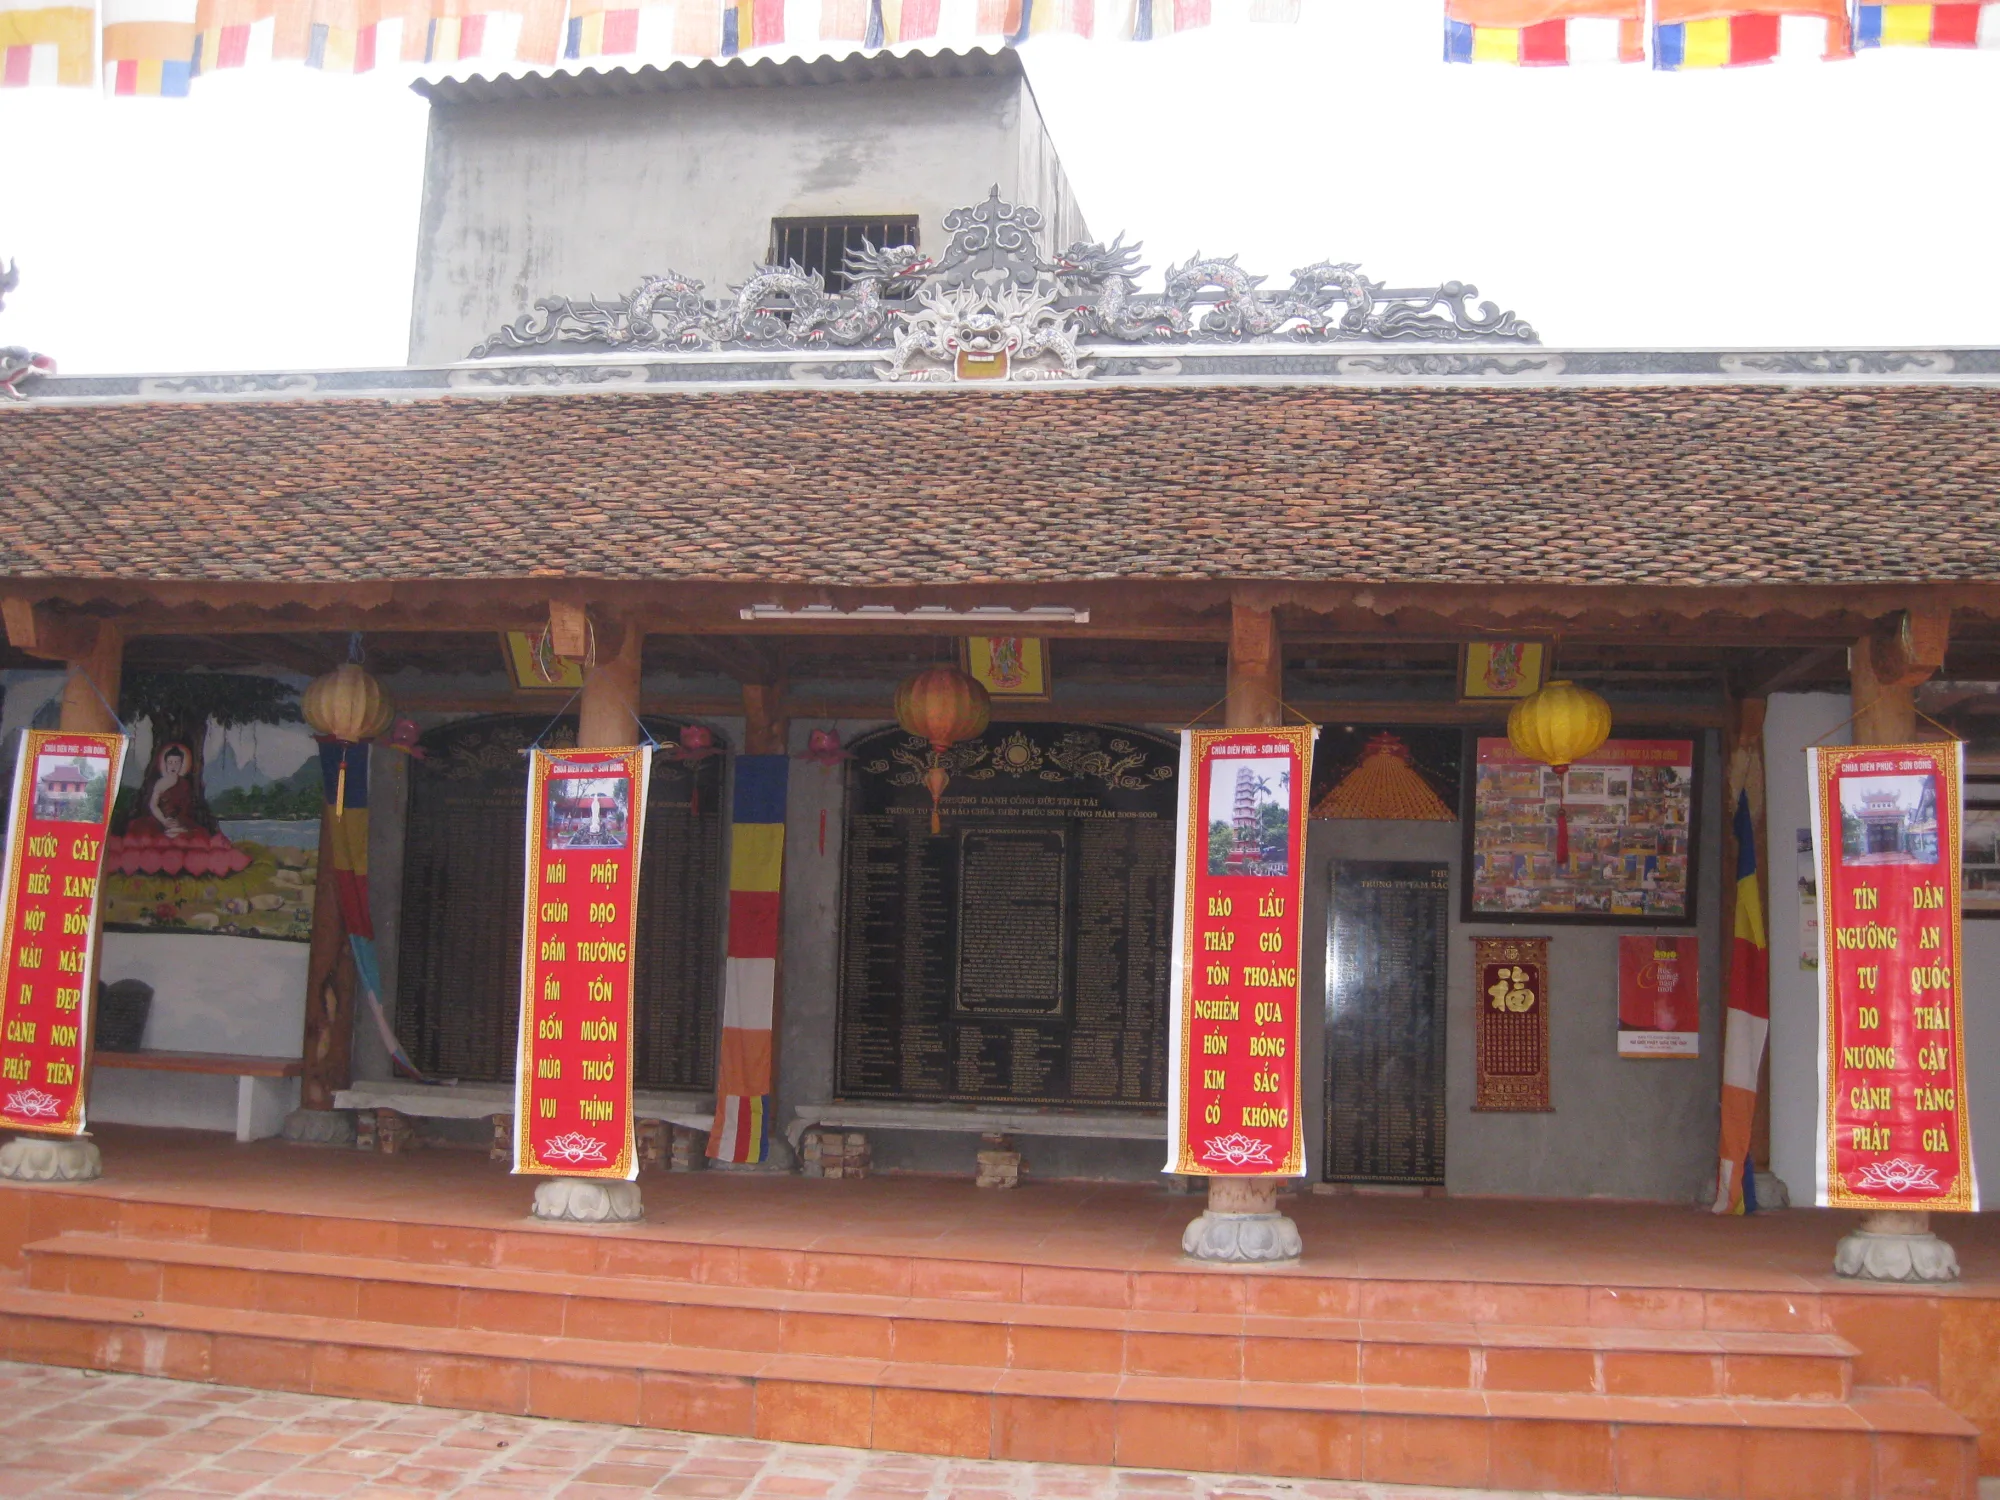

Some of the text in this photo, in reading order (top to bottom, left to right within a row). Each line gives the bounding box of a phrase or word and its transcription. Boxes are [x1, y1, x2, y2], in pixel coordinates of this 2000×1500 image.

[2, 832, 58, 1084] NƯỚC BIẾC MỘT MÀU IN CẢNH PHẬT
[59, 946, 85, 976] MẶT
[63, 905, 90, 935] BỐN
[73, 834, 100, 861] CÂY
[47, 1058, 74, 1084] TIÊN
[51, 1025, 78, 1047] NON
[56, 988, 80, 1014] ĐẸP
[538, 859, 568, 1118] MÁI CHÙA ĐẦM ẤM BỐN MÙA VUI
[577, 859, 626, 1126] PHẬT ĐẠO TRƯỜNG TỒN MUÔN THUỞ THỊNH
[1195, 890, 1239, 1124] BẢO THÁP TÔN NGHIÊM HỒN KIM CỔ
[1242, 888, 1295, 1128] LẦU GIÓ THOẢNG QUA BÓNG SẮC KHÔNG
[1836, 882, 1897, 1155] TÍN NGƯỠNG TỰ DO NƯƠNG CẢNH PHẬT
[1911, 880, 1955, 1152] DÂN AN QUỐC THÁI CẬY TĂNG GIÀ
